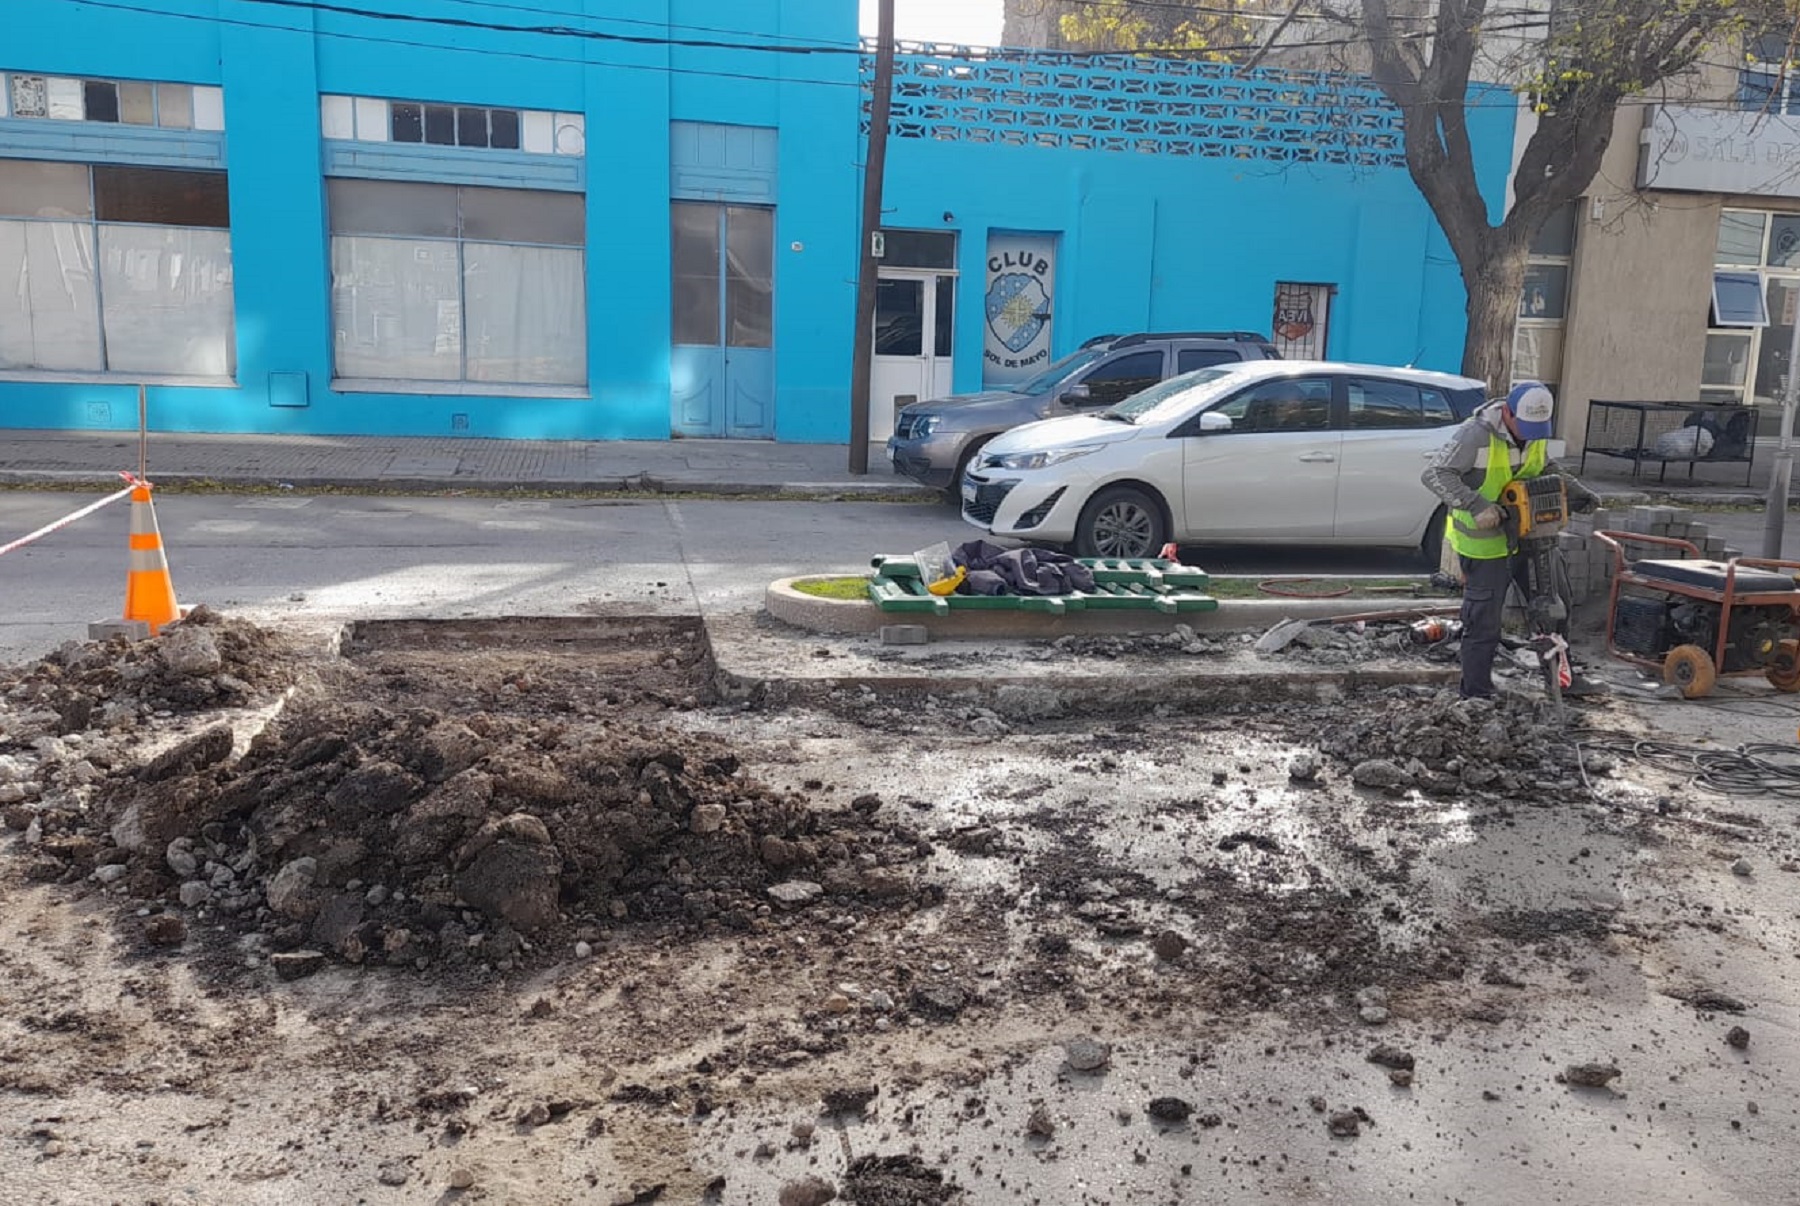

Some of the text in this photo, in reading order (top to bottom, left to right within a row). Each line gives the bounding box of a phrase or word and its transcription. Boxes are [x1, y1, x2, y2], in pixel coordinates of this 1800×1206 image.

[1692, 136, 1756, 165] SALA
[988, 251, 1049, 276] CLUB
[984, 349, 1048, 368] SOL DE MAYO
